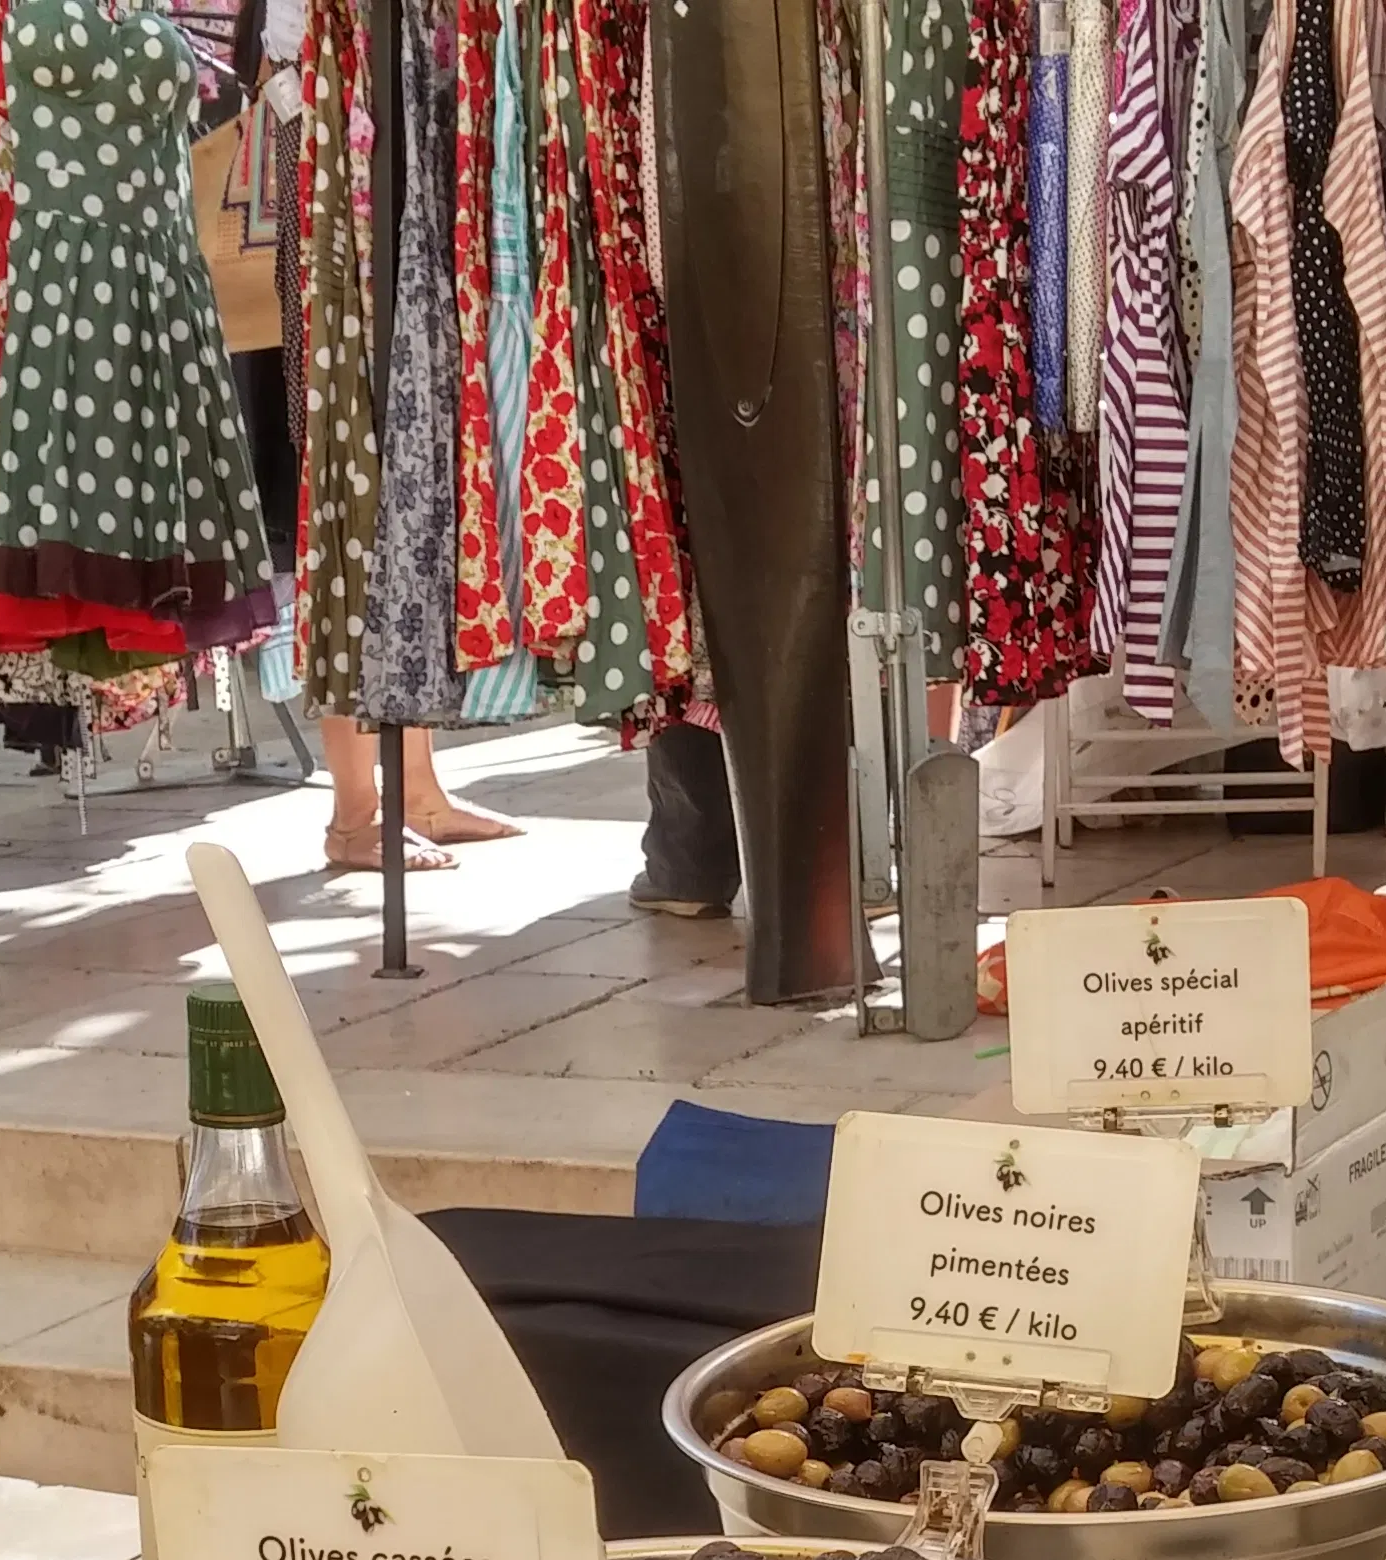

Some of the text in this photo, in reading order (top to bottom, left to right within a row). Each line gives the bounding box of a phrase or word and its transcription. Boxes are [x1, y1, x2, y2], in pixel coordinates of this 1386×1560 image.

[1083, 968, 1239, 997] Olives spécial
[1121, 1013, 1204, 1041] apéritif
[1094, 1056, 1234, 1080] 9,40 € / kilo
[920, 1190, 1096, 1235] Olives noires
[1249, 1217, 1267, 1229] UP
[930, 1247, 1070, 1287] pimentées
[910, 1296, 1078, 1341] 9,40 € / kilo
